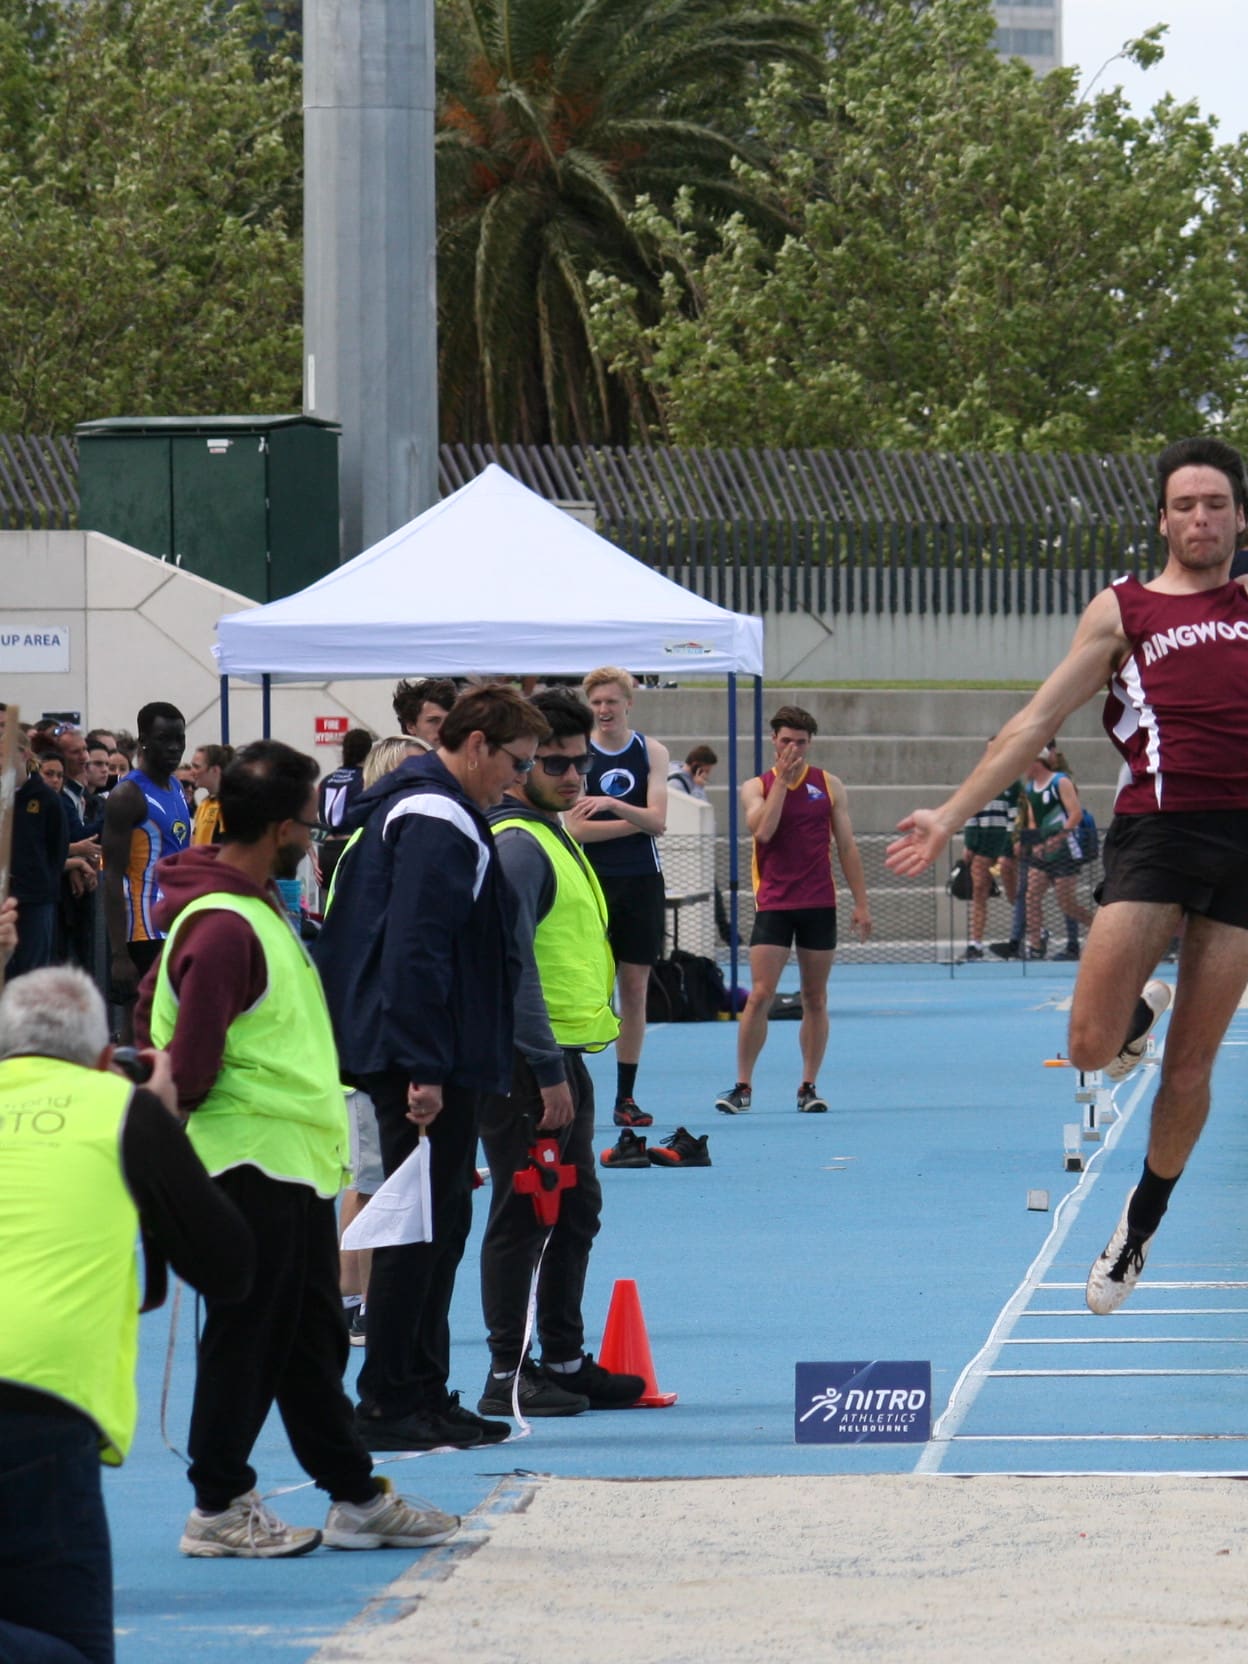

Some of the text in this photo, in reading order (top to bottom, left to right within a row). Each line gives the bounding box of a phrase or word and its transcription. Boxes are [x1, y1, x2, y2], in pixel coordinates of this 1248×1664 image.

[0, 634, 61, 646] UP AREA
[844, 1389, 926, 1410] NITRO
[841, 1413, 917, 1423] ATHLETICS
[839, 1424, 909, 1432] MELBOURNE
